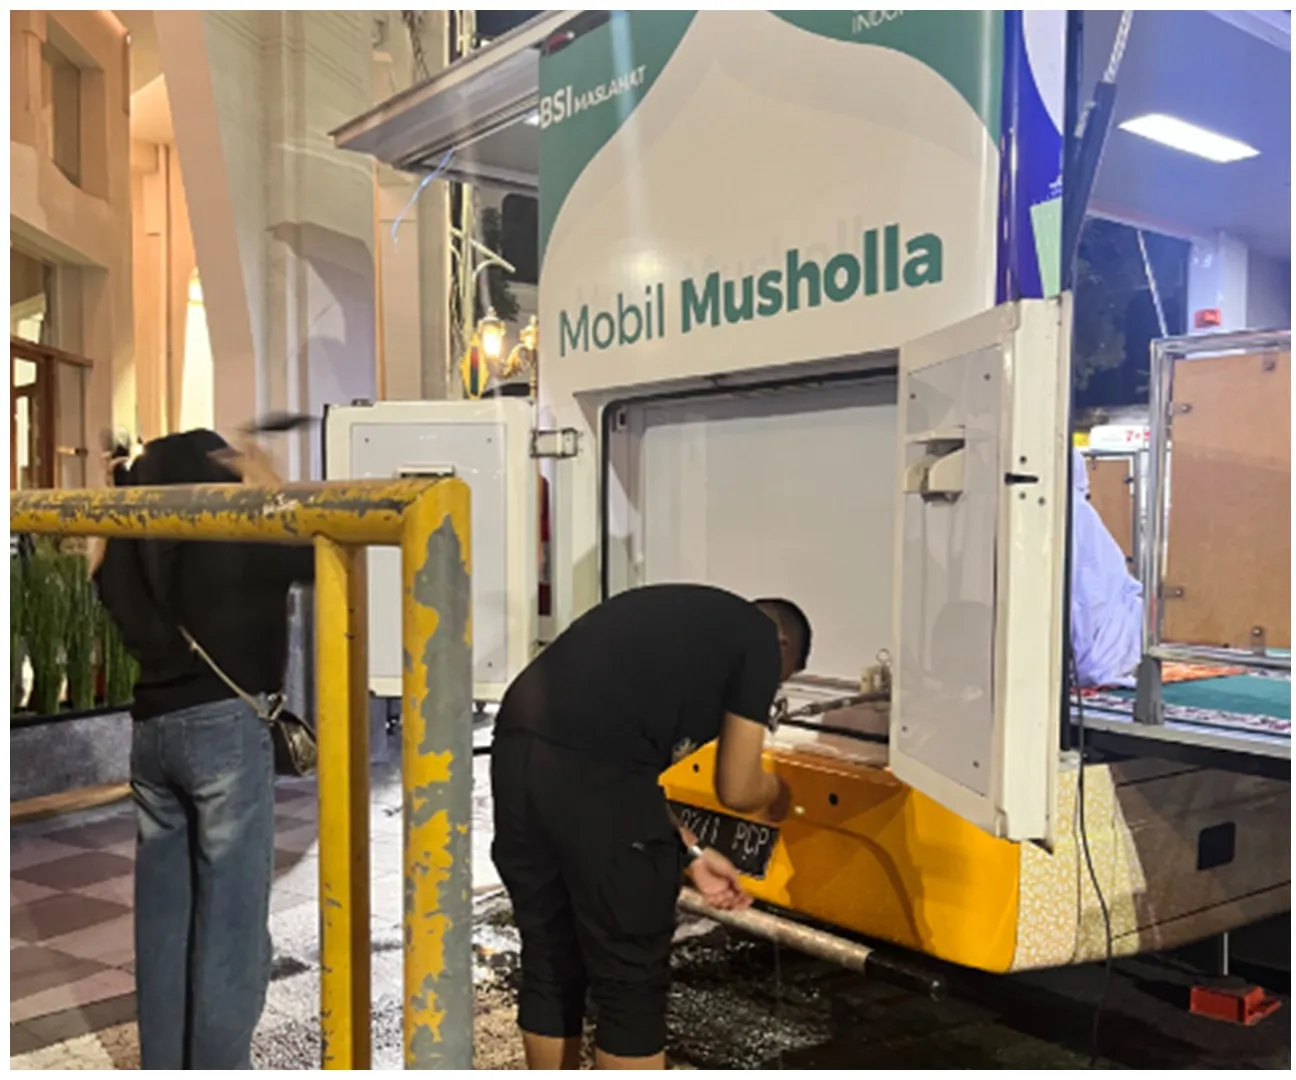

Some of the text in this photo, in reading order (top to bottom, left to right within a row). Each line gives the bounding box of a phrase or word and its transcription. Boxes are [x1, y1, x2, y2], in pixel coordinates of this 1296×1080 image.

[540, 64, 647, 130] BSI MASLAHAT
[558, 222, 943, 358] Mobil Musholla
